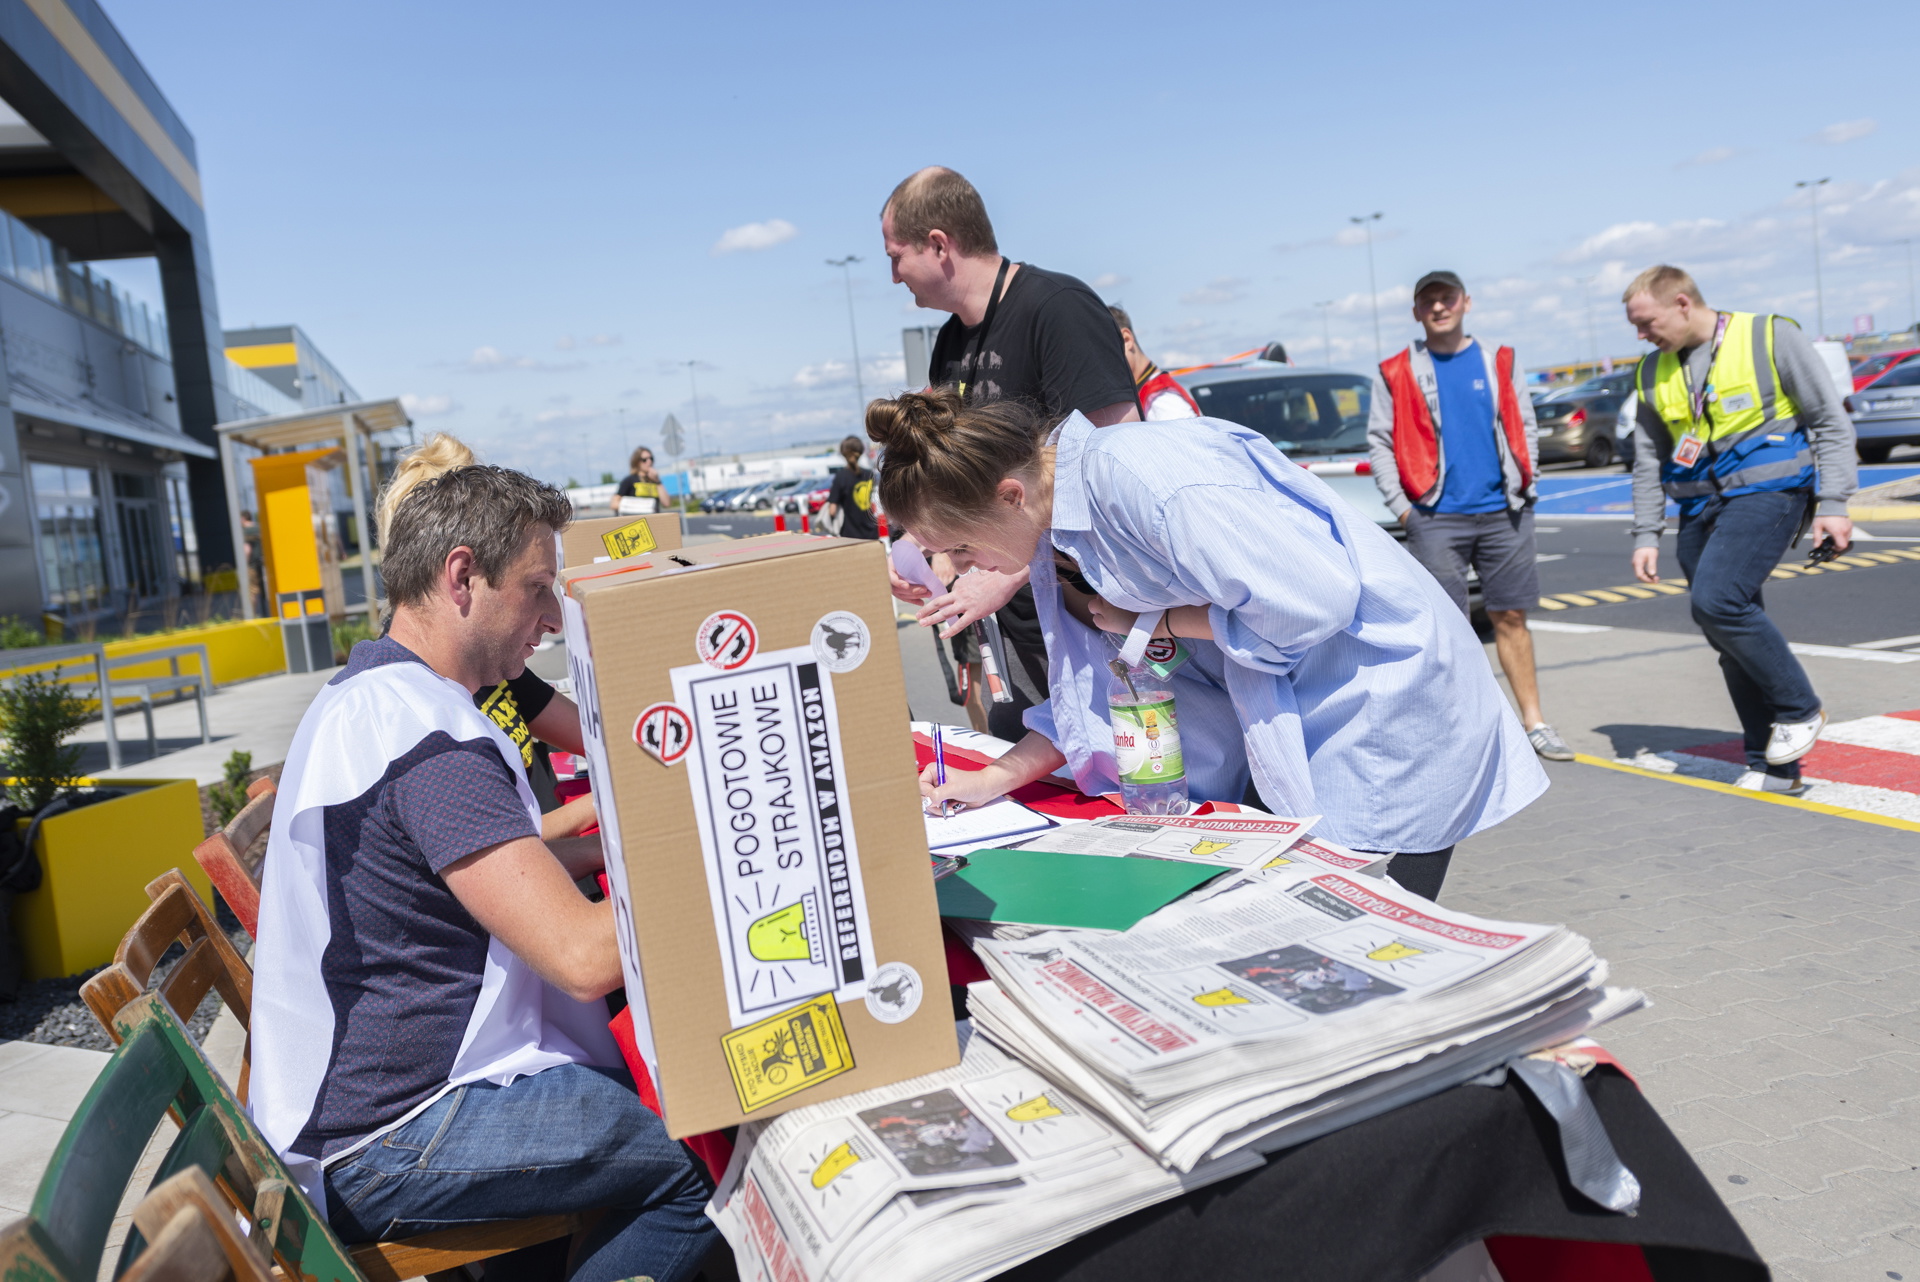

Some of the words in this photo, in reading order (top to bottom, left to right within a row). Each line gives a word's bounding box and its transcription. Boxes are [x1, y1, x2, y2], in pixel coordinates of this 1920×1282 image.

[803, 687, 836, 782] AMAZON
[711, 689, 763, 877] POGOTOWIE
[751, 681, 803, 869] STRAJKOWE
[818, 790, 838, 813] W
[1195, 817, 1294, 834] REFERENDUM
[820, 814, 860, 961] REFERENDUM
[1317, 875, 1410, 924] STRAJKOWE
[1406, 913, 1516, 949] REFERENDUM
[790, 1018, 810, 1056] SZYBKO
[802, 1024, 822, 1062] UMIERA
[736, 1042, 753, 1078] SZYBKO
[747, 1047, 764, 1085] PRACUJE
[746, 1077, 760, 1097] KTO
